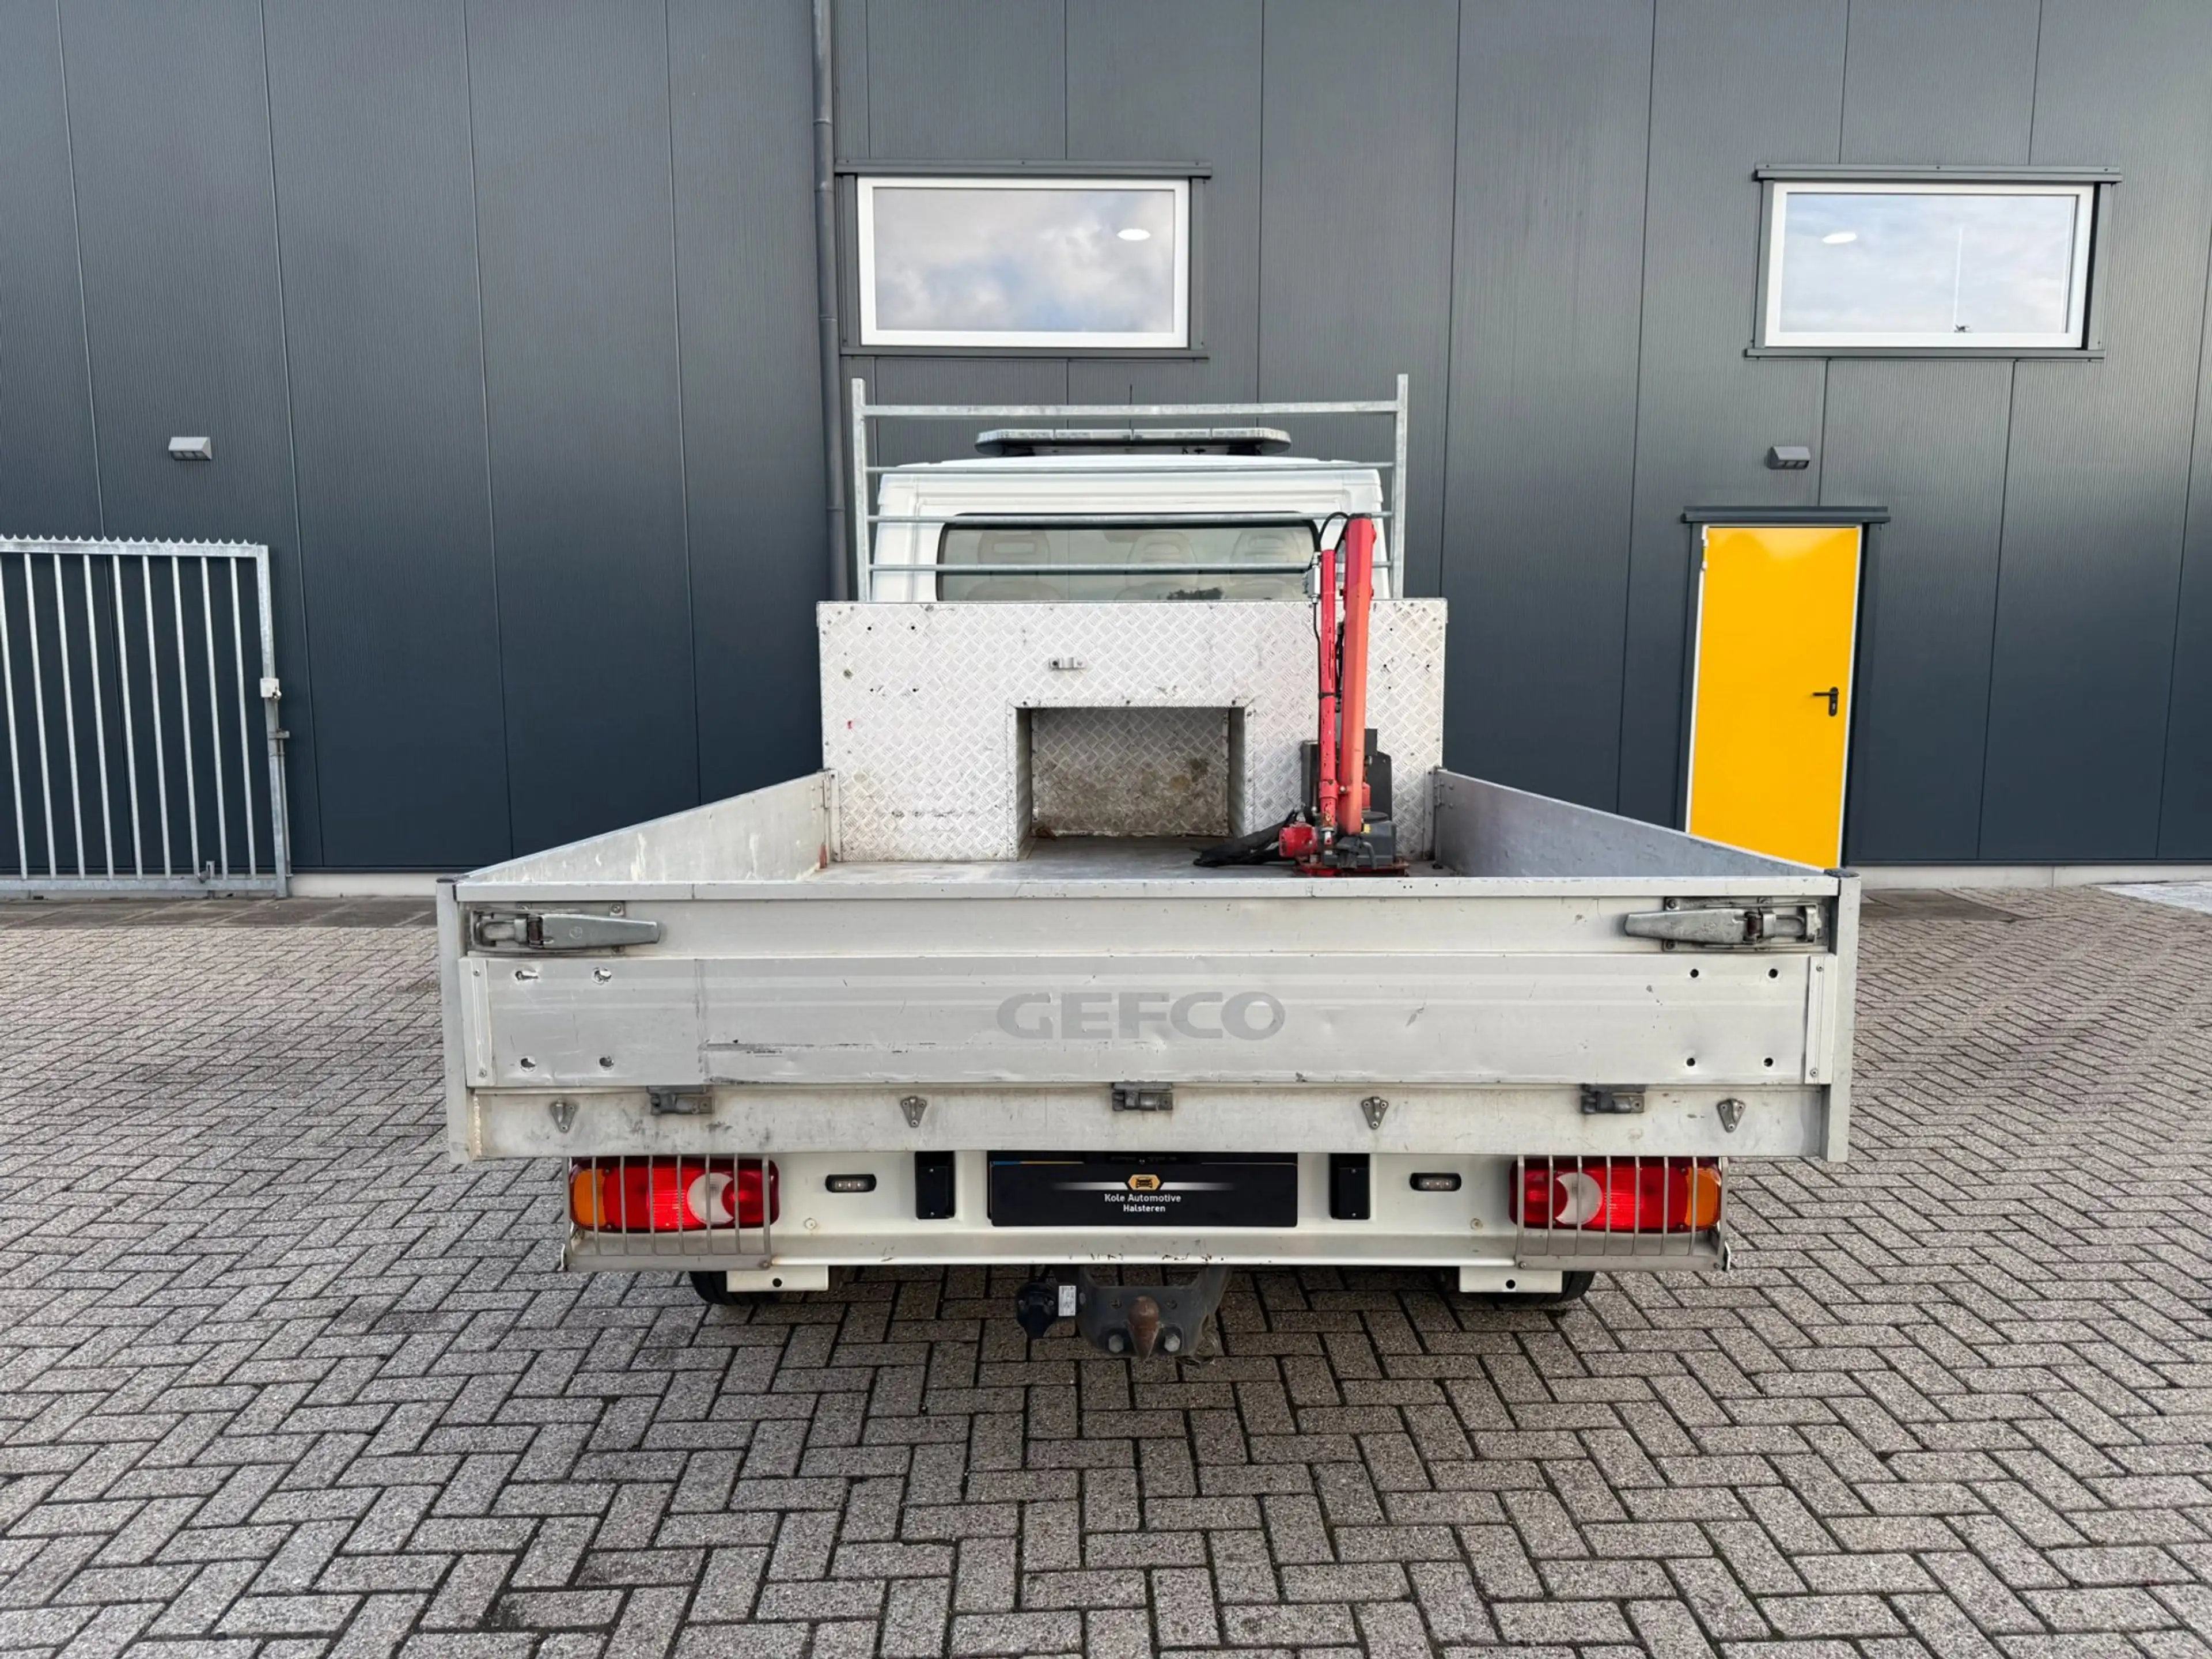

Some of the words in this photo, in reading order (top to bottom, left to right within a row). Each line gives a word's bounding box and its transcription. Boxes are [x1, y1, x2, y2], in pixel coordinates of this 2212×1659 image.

[997, 991, 1286, 1040] GEFCO
[1104, 1194, 1125, 1202] Kole
[1127, 1194, 1181, 1202] Automotive
[1123, 1204, 1166, 1212] Halsteren
